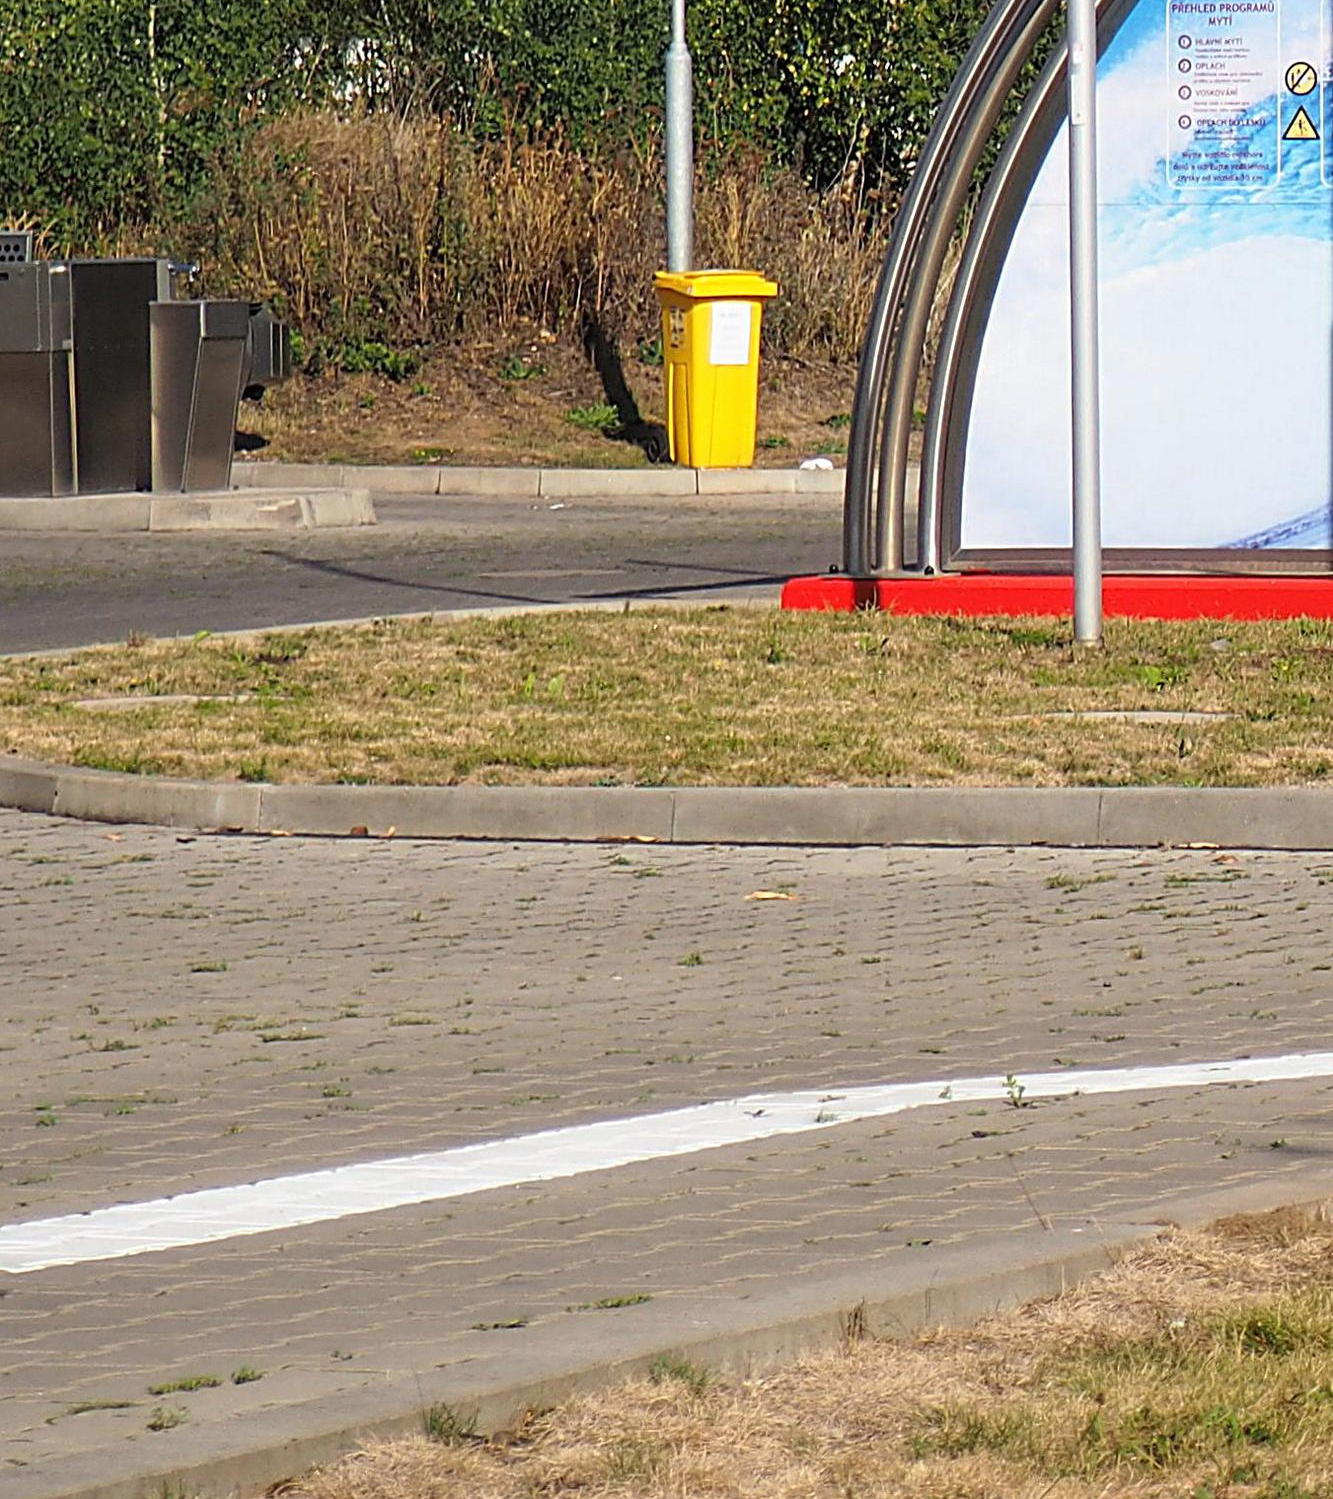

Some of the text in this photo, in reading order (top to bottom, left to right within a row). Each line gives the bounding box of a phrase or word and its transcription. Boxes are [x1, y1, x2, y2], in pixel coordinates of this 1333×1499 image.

[1171, 0, 1275, 13] PŘEHLED PROGRAMŮ
[1208, 14, 1233, 27] MYTÍ
